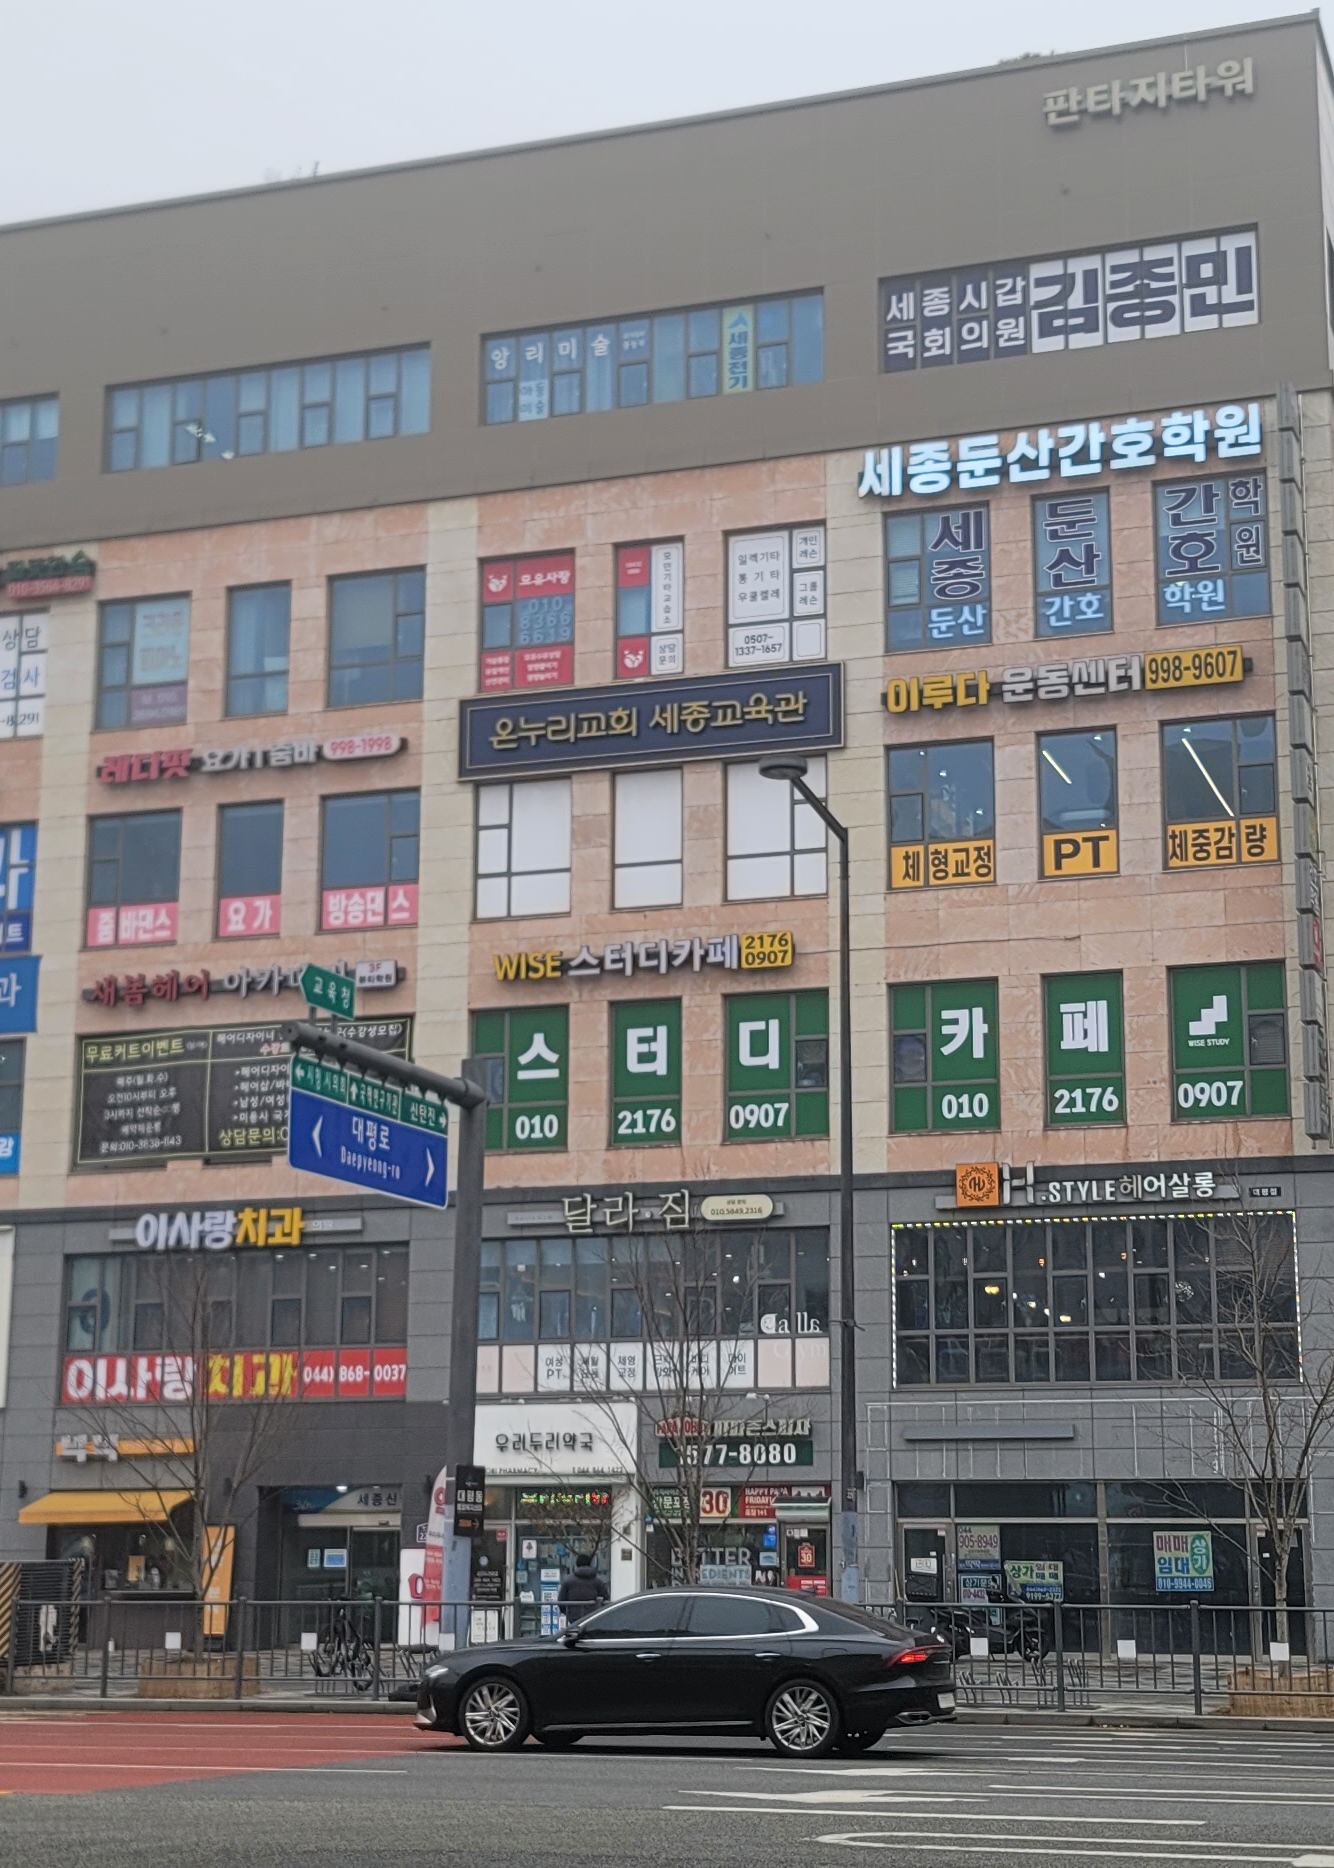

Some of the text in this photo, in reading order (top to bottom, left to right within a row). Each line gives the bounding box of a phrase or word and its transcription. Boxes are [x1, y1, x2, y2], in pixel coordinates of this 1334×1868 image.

[1042, 57, 1253, 126] 판타지타워
[885, 277, 1026, 322] 세종시갑
[1031, 245, 1255, 338] 김종민
[886, 316, 1026, 359] 국회의원
[858, 403, 1262, 498] 세종둔산간호학원
[1164, 483, 1222, 577] 간호
[1229, 477, 1262, 566] 학원
[929, 509, 987, 600] 세종
[1042, 497, 1102, 590] 둔산
[927, 578, 1227, 639] 둔산 간호 학원
[886, 649, 1238, 714] 이루다 운동센터 998-9607
[489, 691, 808, 750] 온누리교회 세종교육관
[902, 824, 1267, 882] 체형교정 PT 체중감량
[227, 903, 272, 932] 요가
[493, 934, 739, 981] WISE 스터디카페
[745, 934, 789, 949] 2176
[745, 950, 789, 966] 0907
[313, 977, 351, 1009] 교육청
[85, 1038, 185, 1062] 무료커트이벤트
[517, 1000, 1109, 1080] 스 터 디 카 페
[1188, 1038, 1230, 1047] WISE STUDY
[410, 1103, 436, 1127] 신탄진
[942, 1080, 1243, 1120] 010 2176 0907
[352, 1117, 391, 1151] 대평로
[516, 1103, 789, 1139] 010 2176 0907
[341, 1146, 401, 1181] Daepyeong-ro
[1119, 1172, 1216, 1199] 헤어살롱
[135, 1207, 305, 1249] 이사랑치과
[374, 1364, 406, 1381] 0037
[495, 1432, 593, 1452] 우리두리약국
[701, 1490, 729, 1515] 30
[671, 1547, 752, 1566] BTTER
[1156, 1535, 1189, 1553] 매매
[1010, 1564, 1034, 1579] 상가
[1157, 1557, 1190, 1574] 임대
